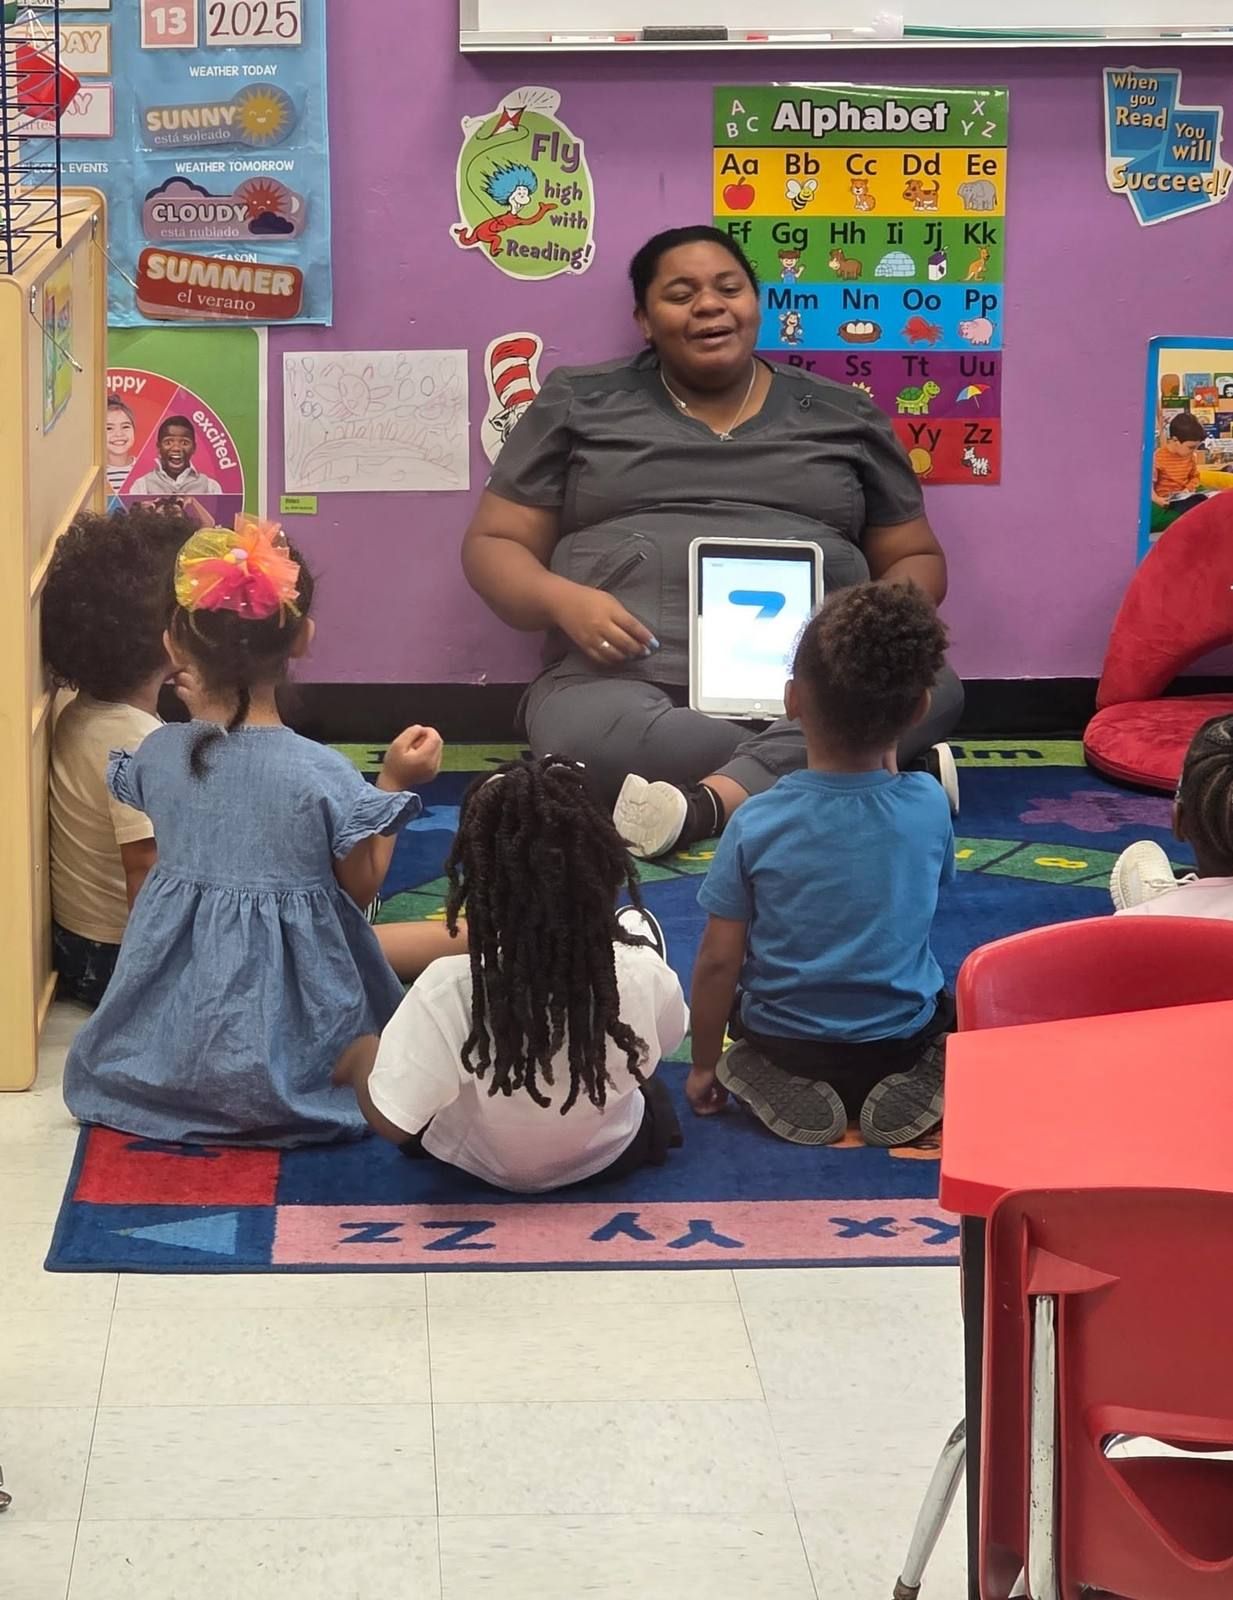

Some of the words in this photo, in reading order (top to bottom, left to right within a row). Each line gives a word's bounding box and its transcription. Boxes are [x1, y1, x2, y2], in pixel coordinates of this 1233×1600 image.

[151, 8, 187, 35] 13
[209, 2, 298, 37] 2025
[189, 66, 239, 77] WEATHER
[243, 65, 278, 76] TODAY
[1112, 72, 1159, 91] When
[731, 99, 746, 115] A
[972, 99, 986, 116] X
[1130, 94, 1156, 107] you
[146, 106, 236, 132] SUNNY
[746, 117, 759, 132] C
[771, 100, 949, 138] Alphabet
[960, 120, 974, 136] Y
[1116, 106, 1168, 130] Read
[183, 129, 231, 142] soleado
[726, 122, 739, 138] B
[981, 121, 997, 138] Z
[1175, 122, 1206, 139] You
[530, 131, 581, 173] Fly
[1173, 140, 1212, 161] will
[69, 162, 109, 173] EVENTS
[175, 162, 225, 173] WEATHER
[229, 160, 295, 172] TOMORROW
[721, 153, 759, 175] Aa
[785, 153, 820, 175] Bb
[846, 154, 877, 176] Cc
[903, 153, 941, 175] Dd
[967, 154, 997, 176] Ee
[1112, 165, 1231, 196] Succeed!
[544, 179, 583, 206] high
[152, 204, 249, 223] CLOUDY
[549, 210, 588, 230] with
[189, 226, 239, 238] nublado
[727, 220, 752, 244] Ff
[771, 222, 808, 251] Gg
[830, 222, 866, 244] Hh
[886, 222, 903, 244] Ii
[923, 222, 943, 251] Jj
[964, 222, 997, 244] Kk
[505, 238, 593, 270] Reading!
[146, 253, 295, 297] SUMMER
[177, 290, 192, 304] el
[198, 296, 256, 311] verano
[767, 288, 819, 309] Mm
[842, 289, 879, 309] Nn
[903, 289, 942, 310] Oo
[965, 289, 997, 318] Pp
[845, 355, 871, 376] Ss
[902, 355, 929, 376] Tt
[959, 356, 995, 376] Uu
[106, 374, 147, 394] appy
[192, 409, 237, 470] excited
[908, 423, 941, 451] Yy
[963, 423, 992, 444] Zz
